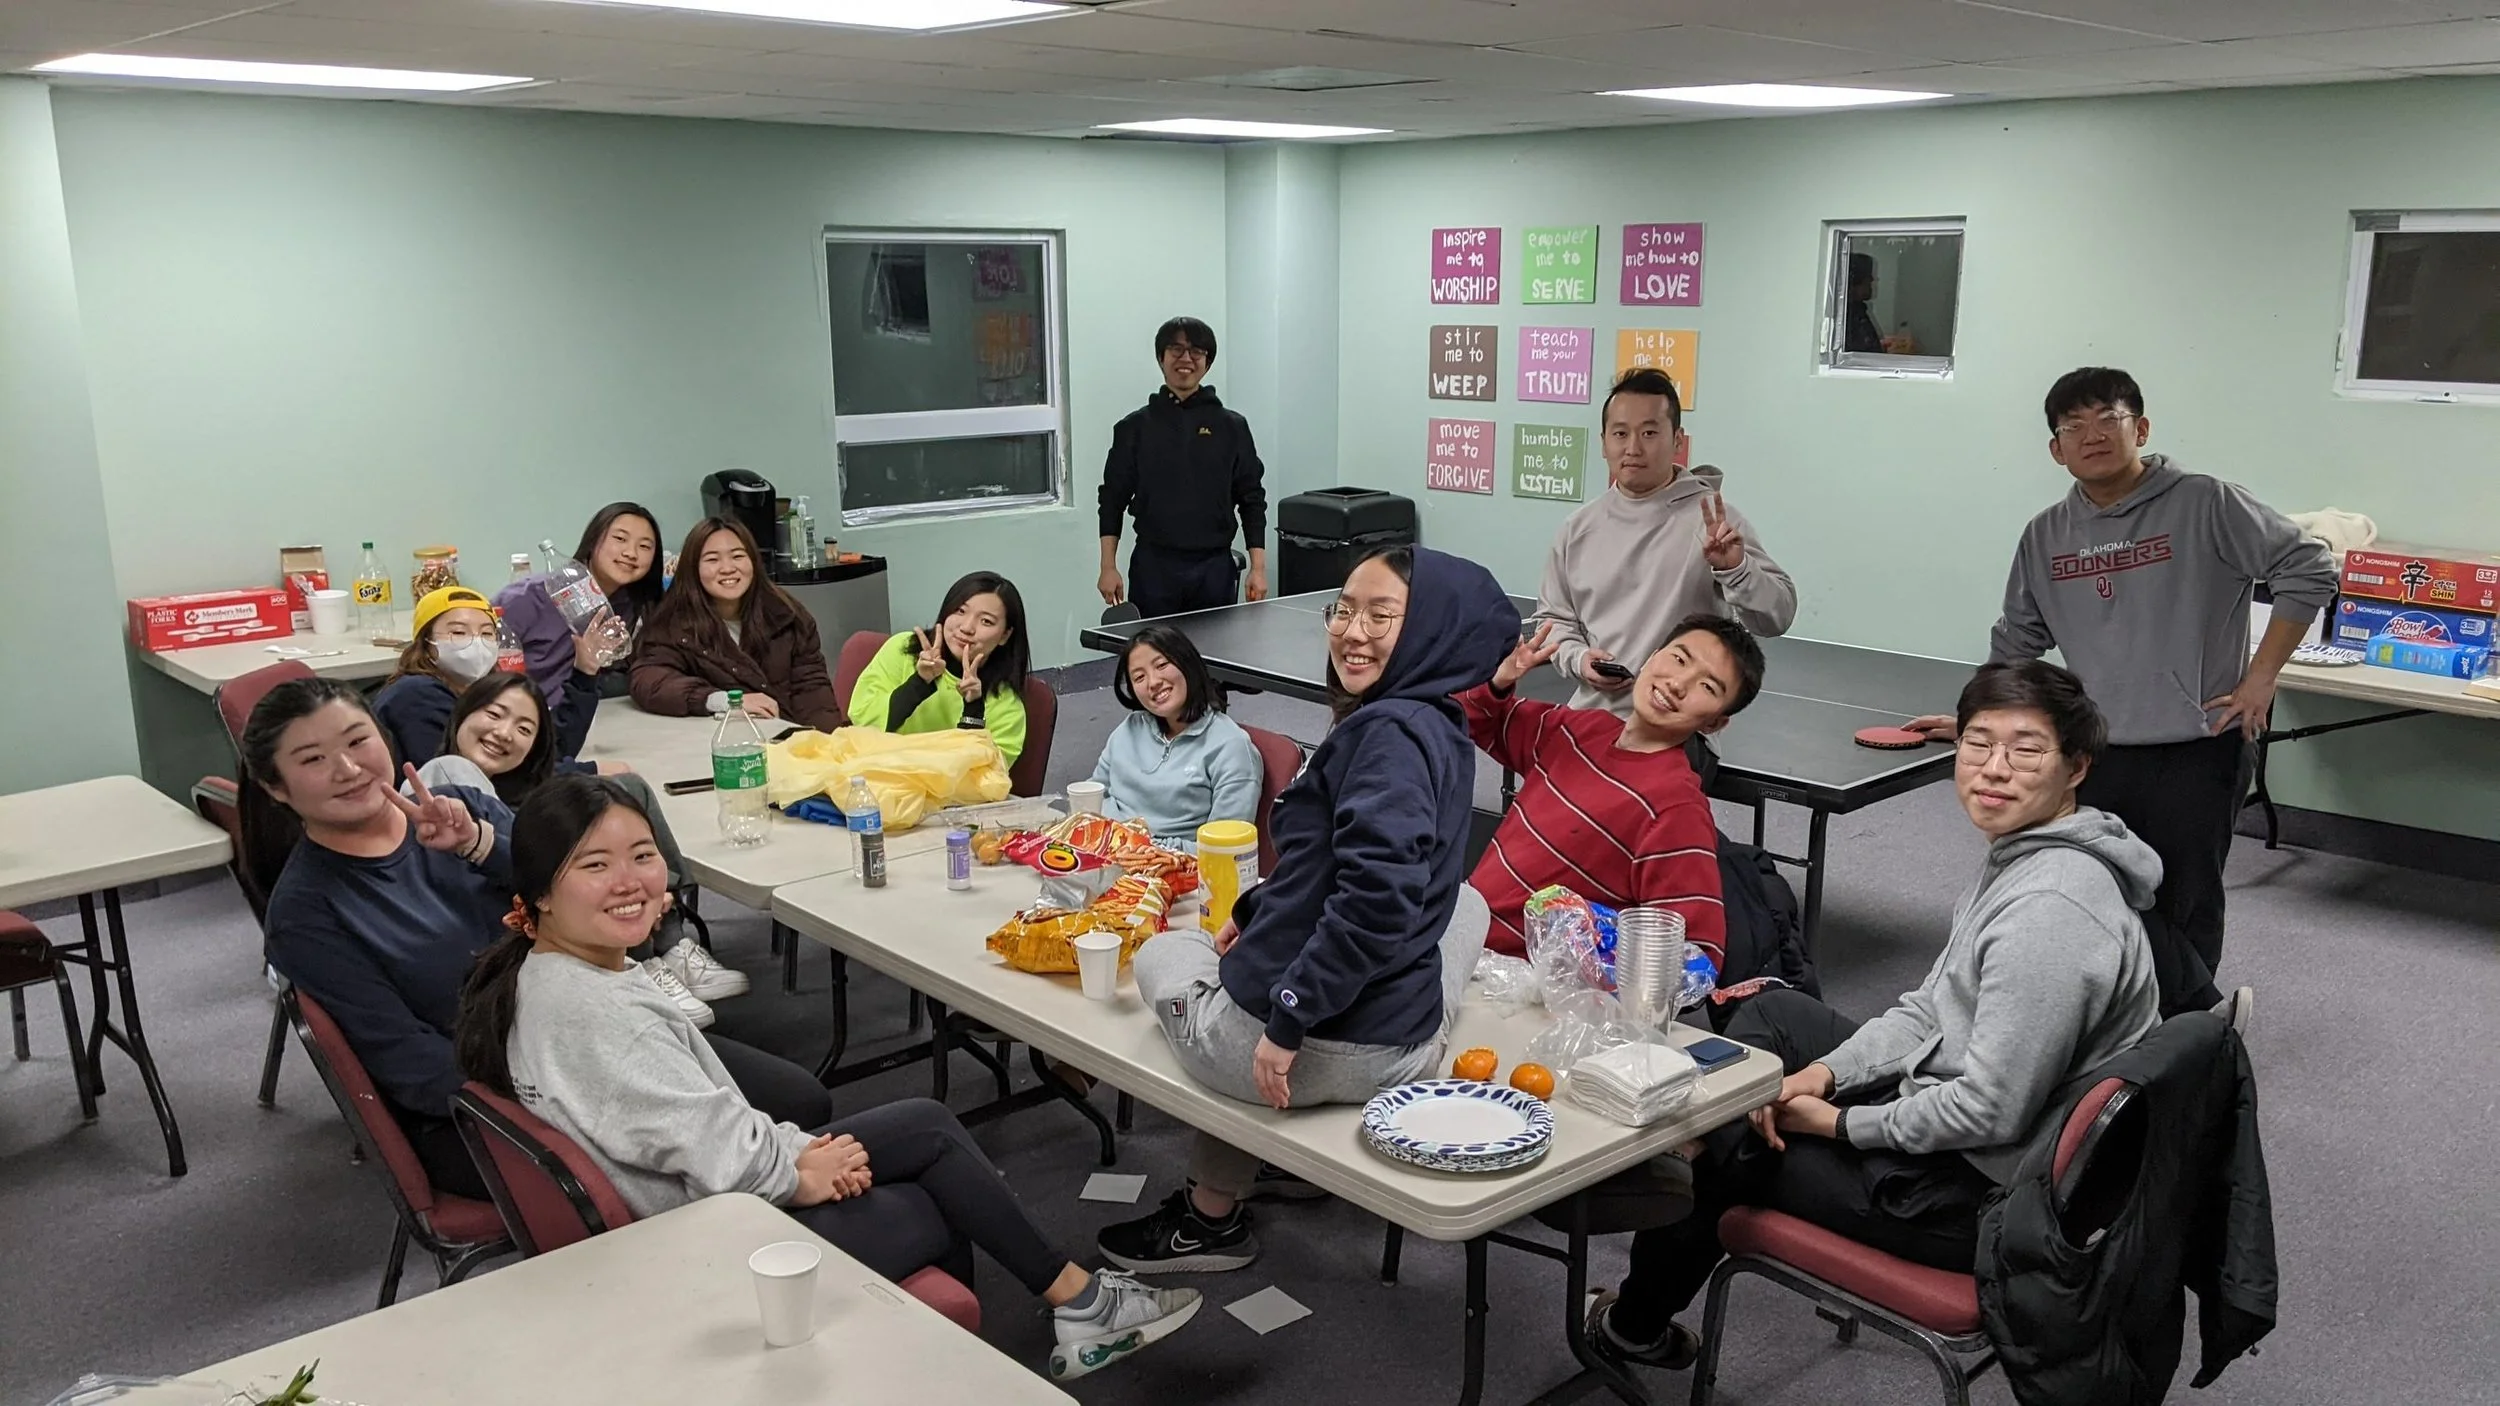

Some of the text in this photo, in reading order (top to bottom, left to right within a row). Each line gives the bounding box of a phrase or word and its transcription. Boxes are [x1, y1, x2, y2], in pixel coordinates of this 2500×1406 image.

[1528, 228, 1588, 251] empower
[1640, 226, 1685, 247] show
[1446, 252, 1484, 268] me to
[1536, 250, 1581, 267] me to
[1625, 249, 1699, 268] me how to
[1432, 276, 1498, 302] WORSHIP
[1532, 277, 1585, 300] SERVE
[1634, 273, 1690, 300] LOVE
[1444, 327, 1481, 346] stir
[1530, 329, 1578, 347] teach
[1635, 330, 1675, 354] help
[1445, 346, 1484, 363] me to
[1531, 347, 1577, 363] me your
[1634, 352, 1674, 367] me to
[1433, 372, 1488, 397] WEEP
[1525, 370, 1588, 396] TRUTH
[1440, 423, 1480, 439] move
[1521, 427, 1572, 448] humble
[1436, 441, 1479, 459] me to
[1523, 453, 1569, 470] me to
[1428, 463, 1490, 490] FORGIVE
[1520, 472, 1574, 496] LISTEN
[2051, 540, 2172, 576] SOONERS
[2365, 558, 2400, 567] NONGSHIM
[2401, 560, 2432, 599] 辛
[2431, 590, 2455, 599] SHIN
[147, 608, 178, 618] PLASTIC
[151, 616, 176, 624] FORKS
[2357, 606, 2393, 616] NONGSHIM
[2391, 617, 2427, 635] Bowl
